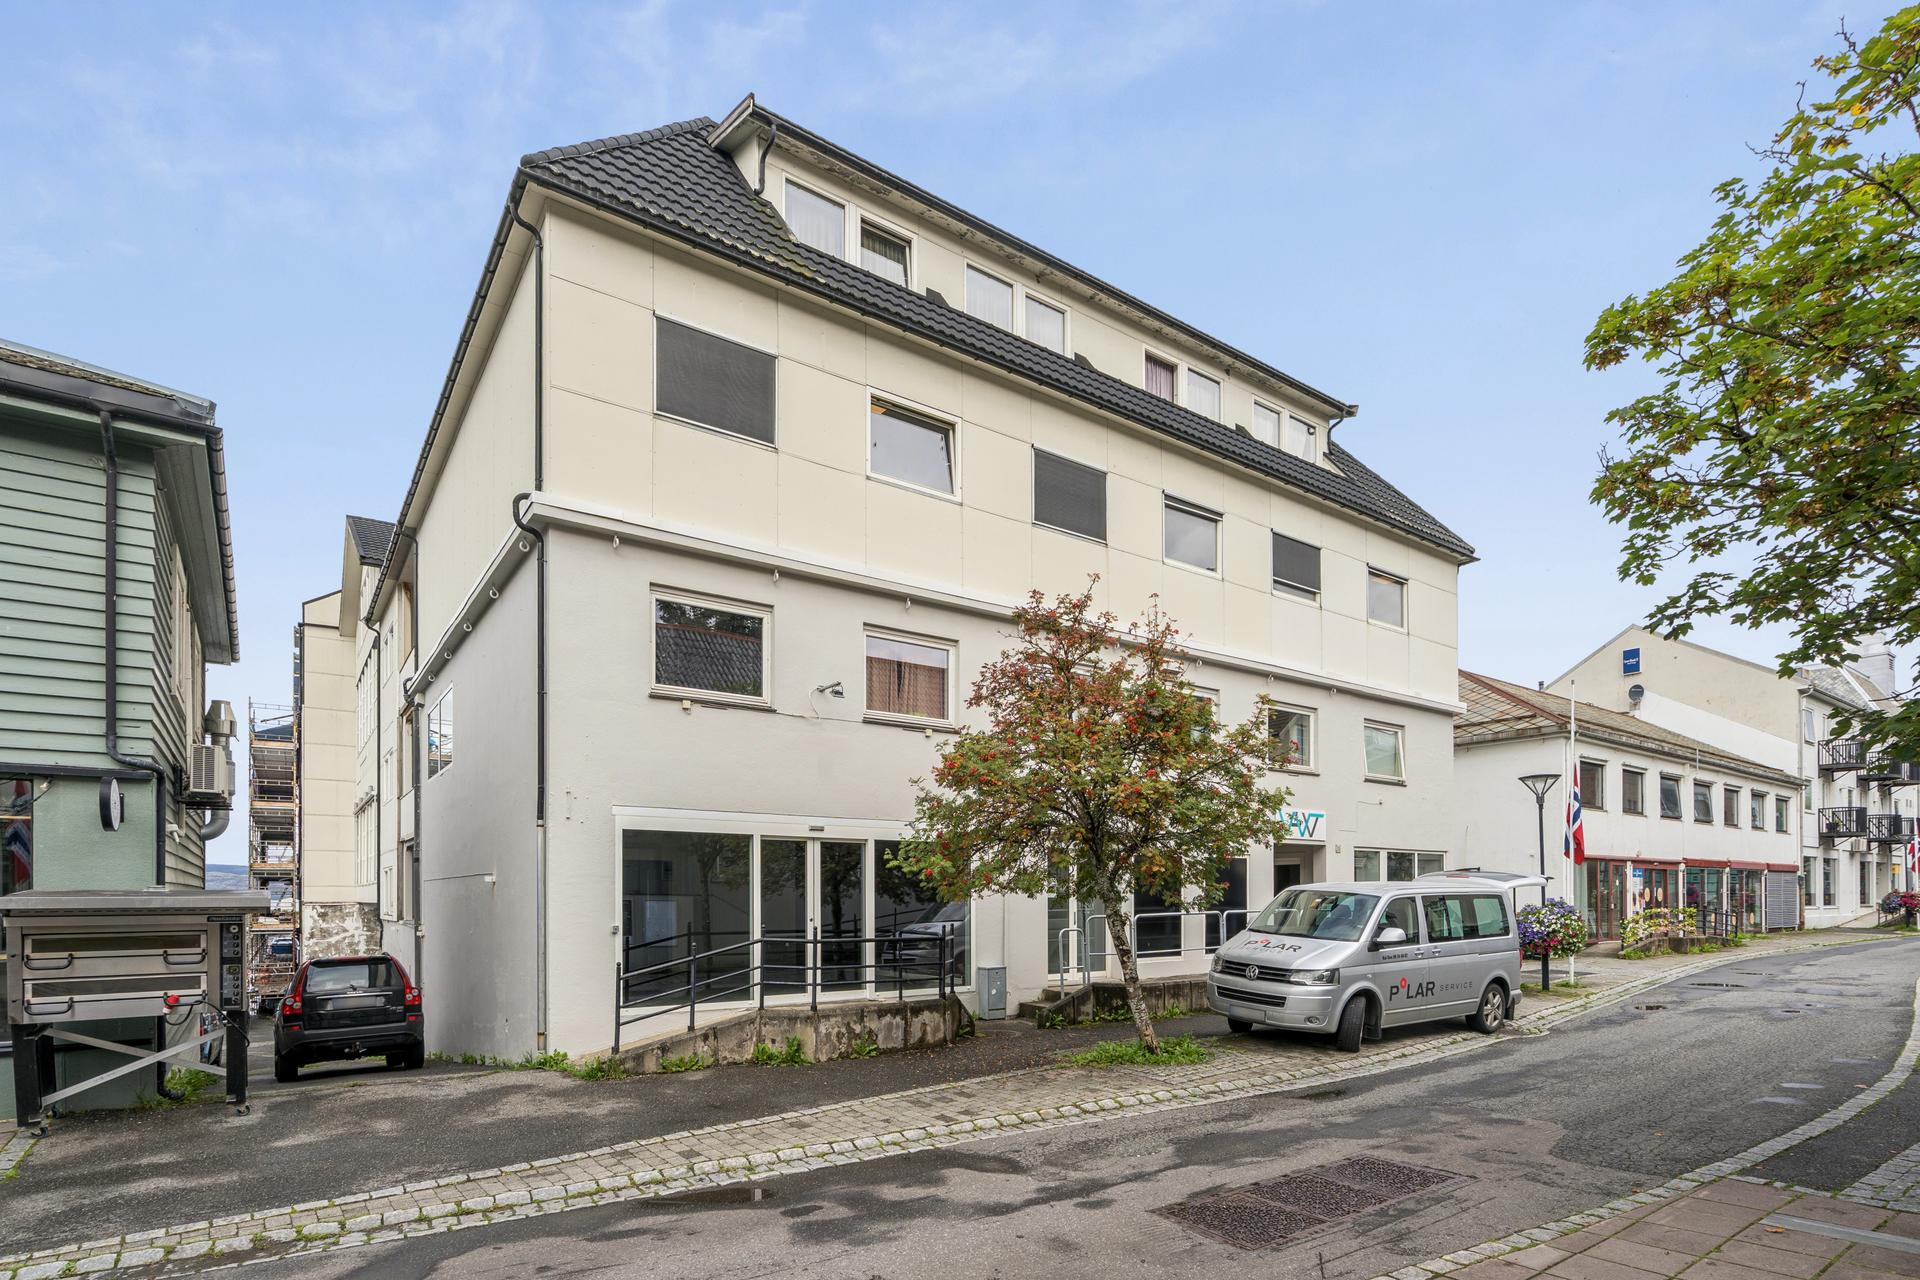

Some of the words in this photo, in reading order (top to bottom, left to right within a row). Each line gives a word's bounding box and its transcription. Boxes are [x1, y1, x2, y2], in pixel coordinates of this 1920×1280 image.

[1244, 938, 1303, 953] POLAR
[1389, 977, 1436, 1002] POLAR
[1439, 981, 1473, 992] SERVICE
